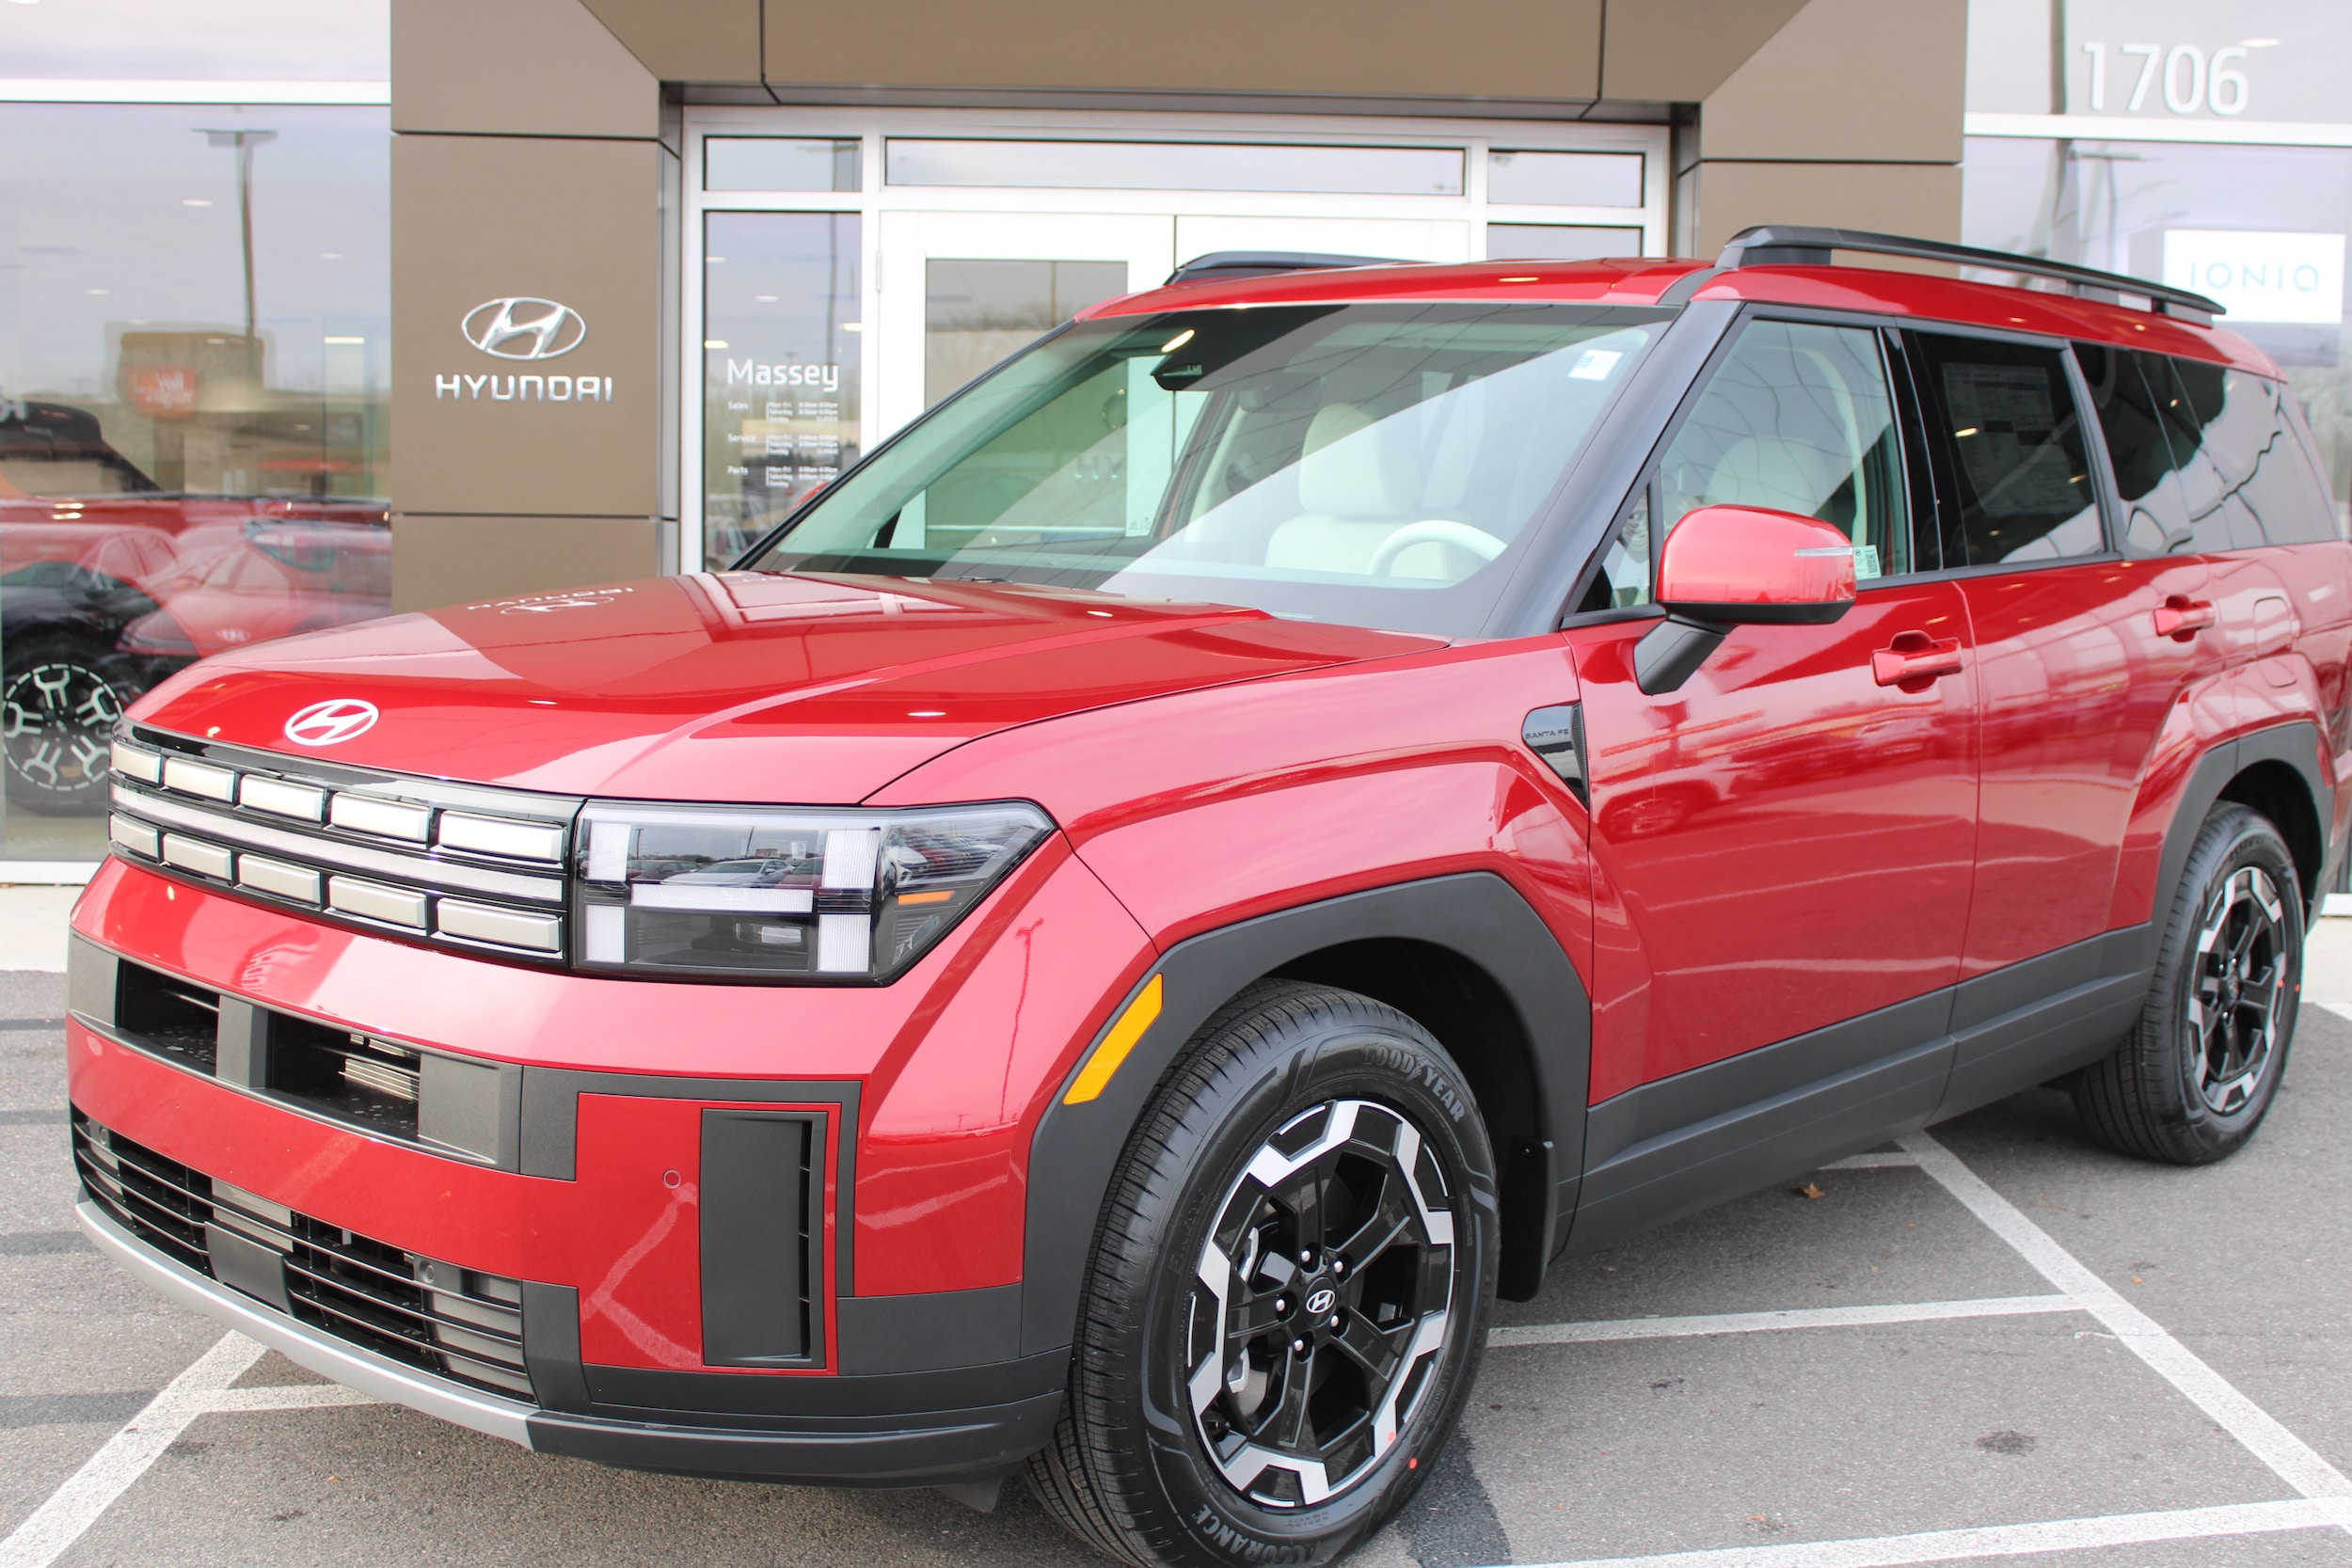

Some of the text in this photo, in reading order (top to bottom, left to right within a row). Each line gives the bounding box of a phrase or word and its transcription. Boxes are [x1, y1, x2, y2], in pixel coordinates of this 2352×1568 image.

[2082, 41, 2249, 116] 1706
[2189, 261, 2320, 292] IONIQ
[436, 373, 613, 402] HYUNDAI
[726, 357, 839, 392] Massey
[1525, 730, 1556, 739] SANTA
